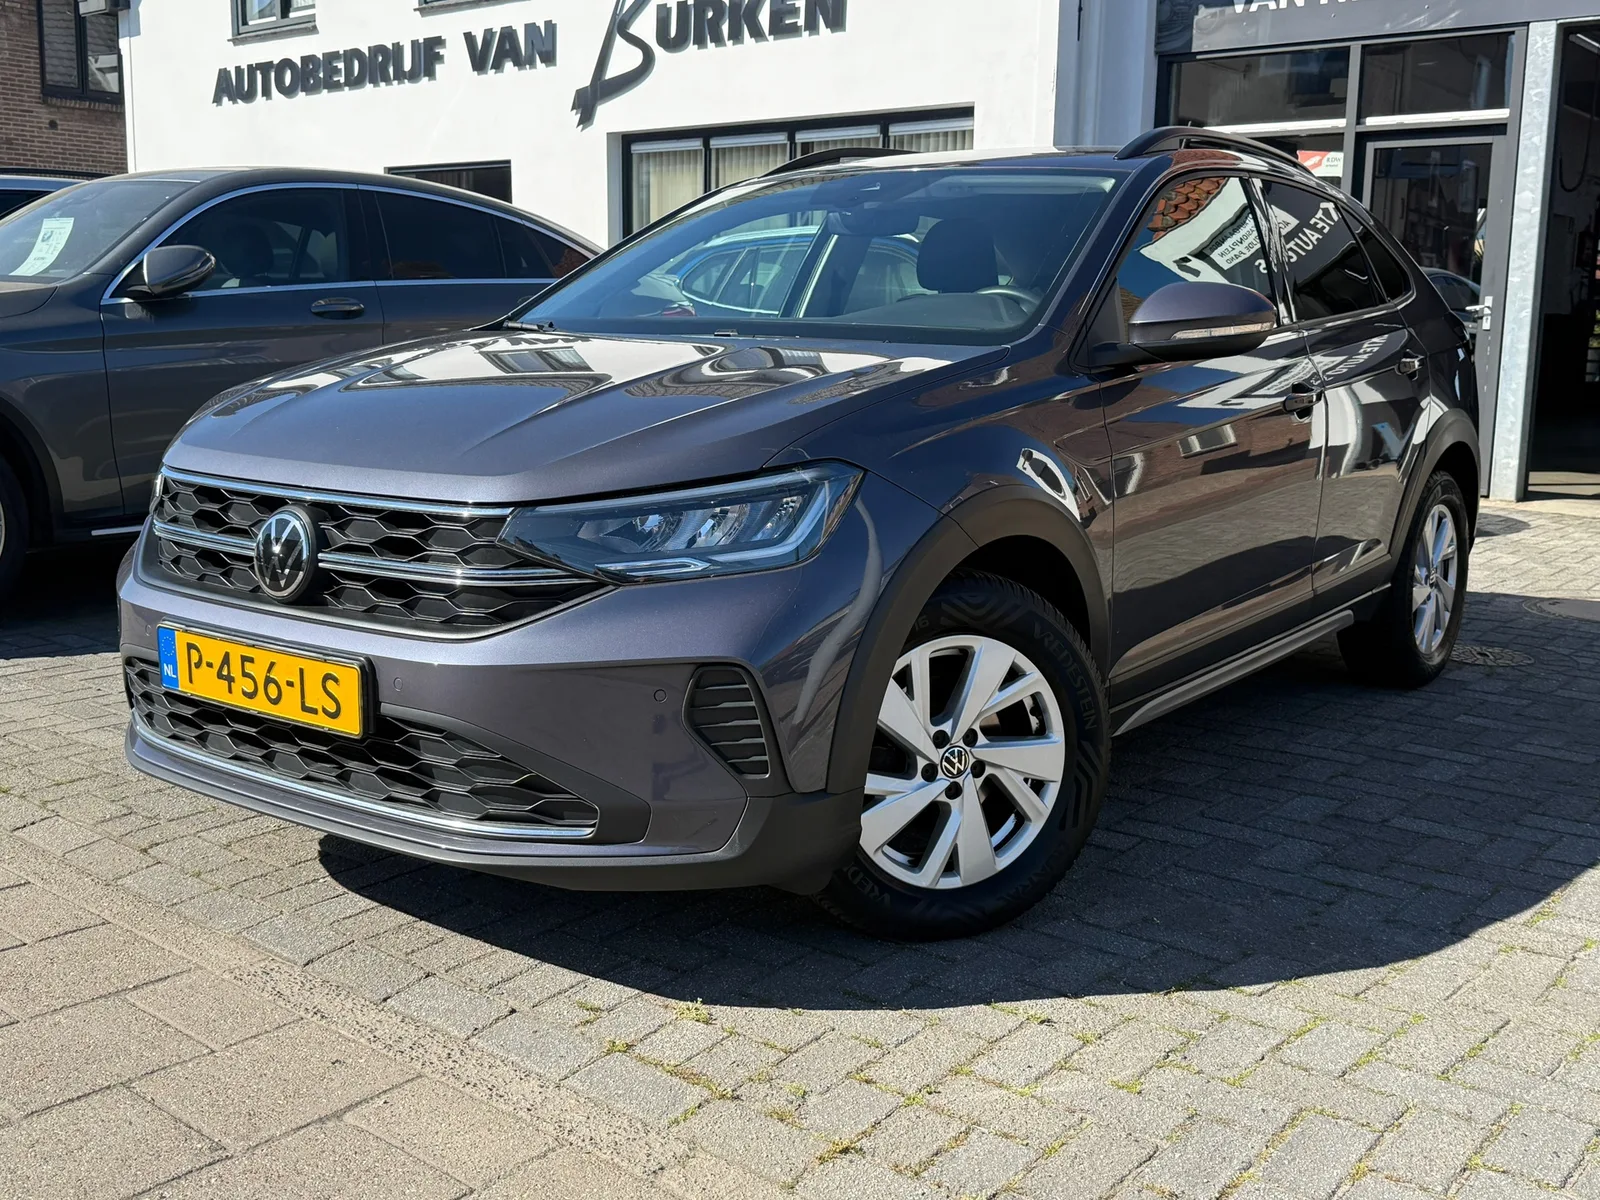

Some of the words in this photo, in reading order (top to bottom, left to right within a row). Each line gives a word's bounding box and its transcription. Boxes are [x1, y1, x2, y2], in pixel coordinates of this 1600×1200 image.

[211, 37, 446, 107] AUTOBEDRIJF
[463, 20, 557, 75] VAN
[163, 663, 176, 678] NL
[186, 642, 341, 719] P-456-LS
[1031, 620, 1098, 731] VREDESTEIN
